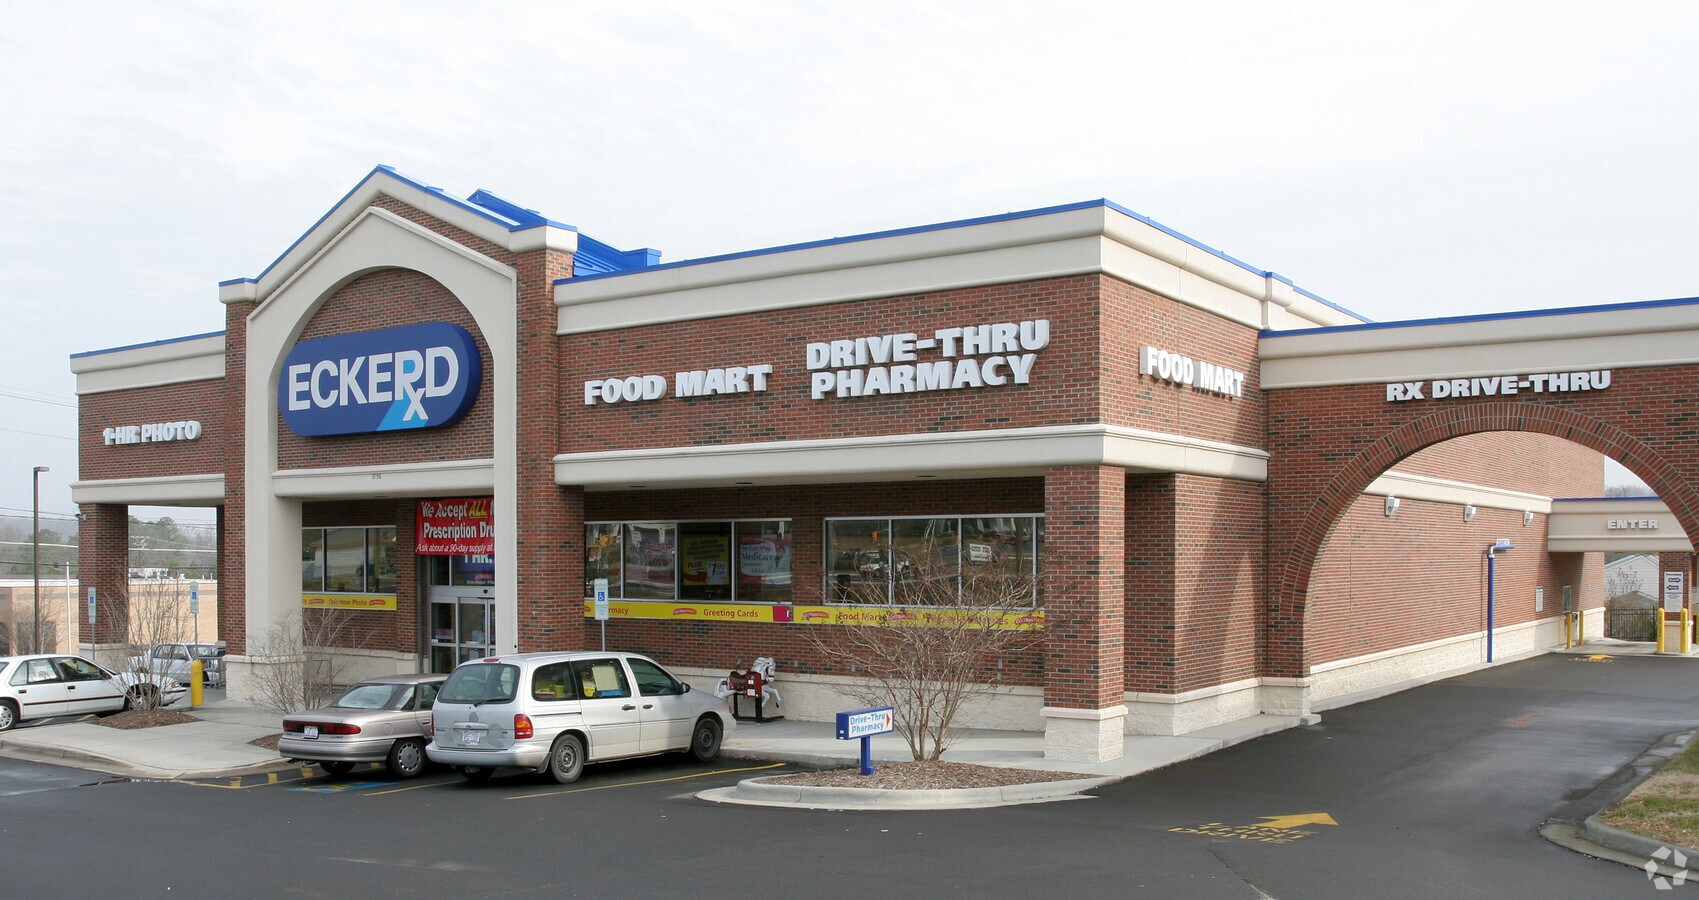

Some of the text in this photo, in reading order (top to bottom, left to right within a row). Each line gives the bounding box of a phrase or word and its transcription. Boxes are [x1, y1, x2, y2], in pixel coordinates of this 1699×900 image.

[807, 319, 1050, 370] DRIVE-THRU
[811, 353, 1038, 400] PHARMACY
[1140, 346, 1244, 397] FOOD MART
[288, 346, 460, 416] ECKERD
[585, 364, 773, 405] FOOD MART
[1386, 370, 1611, 402] RX DRIVE-THRU
[103, 420, 202, 445] 1-HR PHOTO
[421, 502, 435, 518] We
[434, 502, 468, 520] Accept
[469, 500, 487, 519] ALL
[423, 521, 495, 542] Prescription Dru
[1607, 519, 1659, 529] ENTER
[415, 542, 429, 553] Ask
[428, 543, 444, 552] about
[449, 543, 468, 553] 90-day
[469, 543, 485, 554] supply
[486, 544, 493, 552] at
[741, 552, 774, 561] Medicare
[339, 597, 352, 606] Hour
[352, 597, 367, 606] Photo
[608, 607, 629, 616] rmacy
[703, 608, 735, 619] Greeting
[737, 609, 759, 618] Cards
[839, 611, 859, 620] Food
[861, 612, 884, 621] Mar
[850, 712, 886, 726] Drive-Thru
[851, 722, 884, 734] Pharmacy
